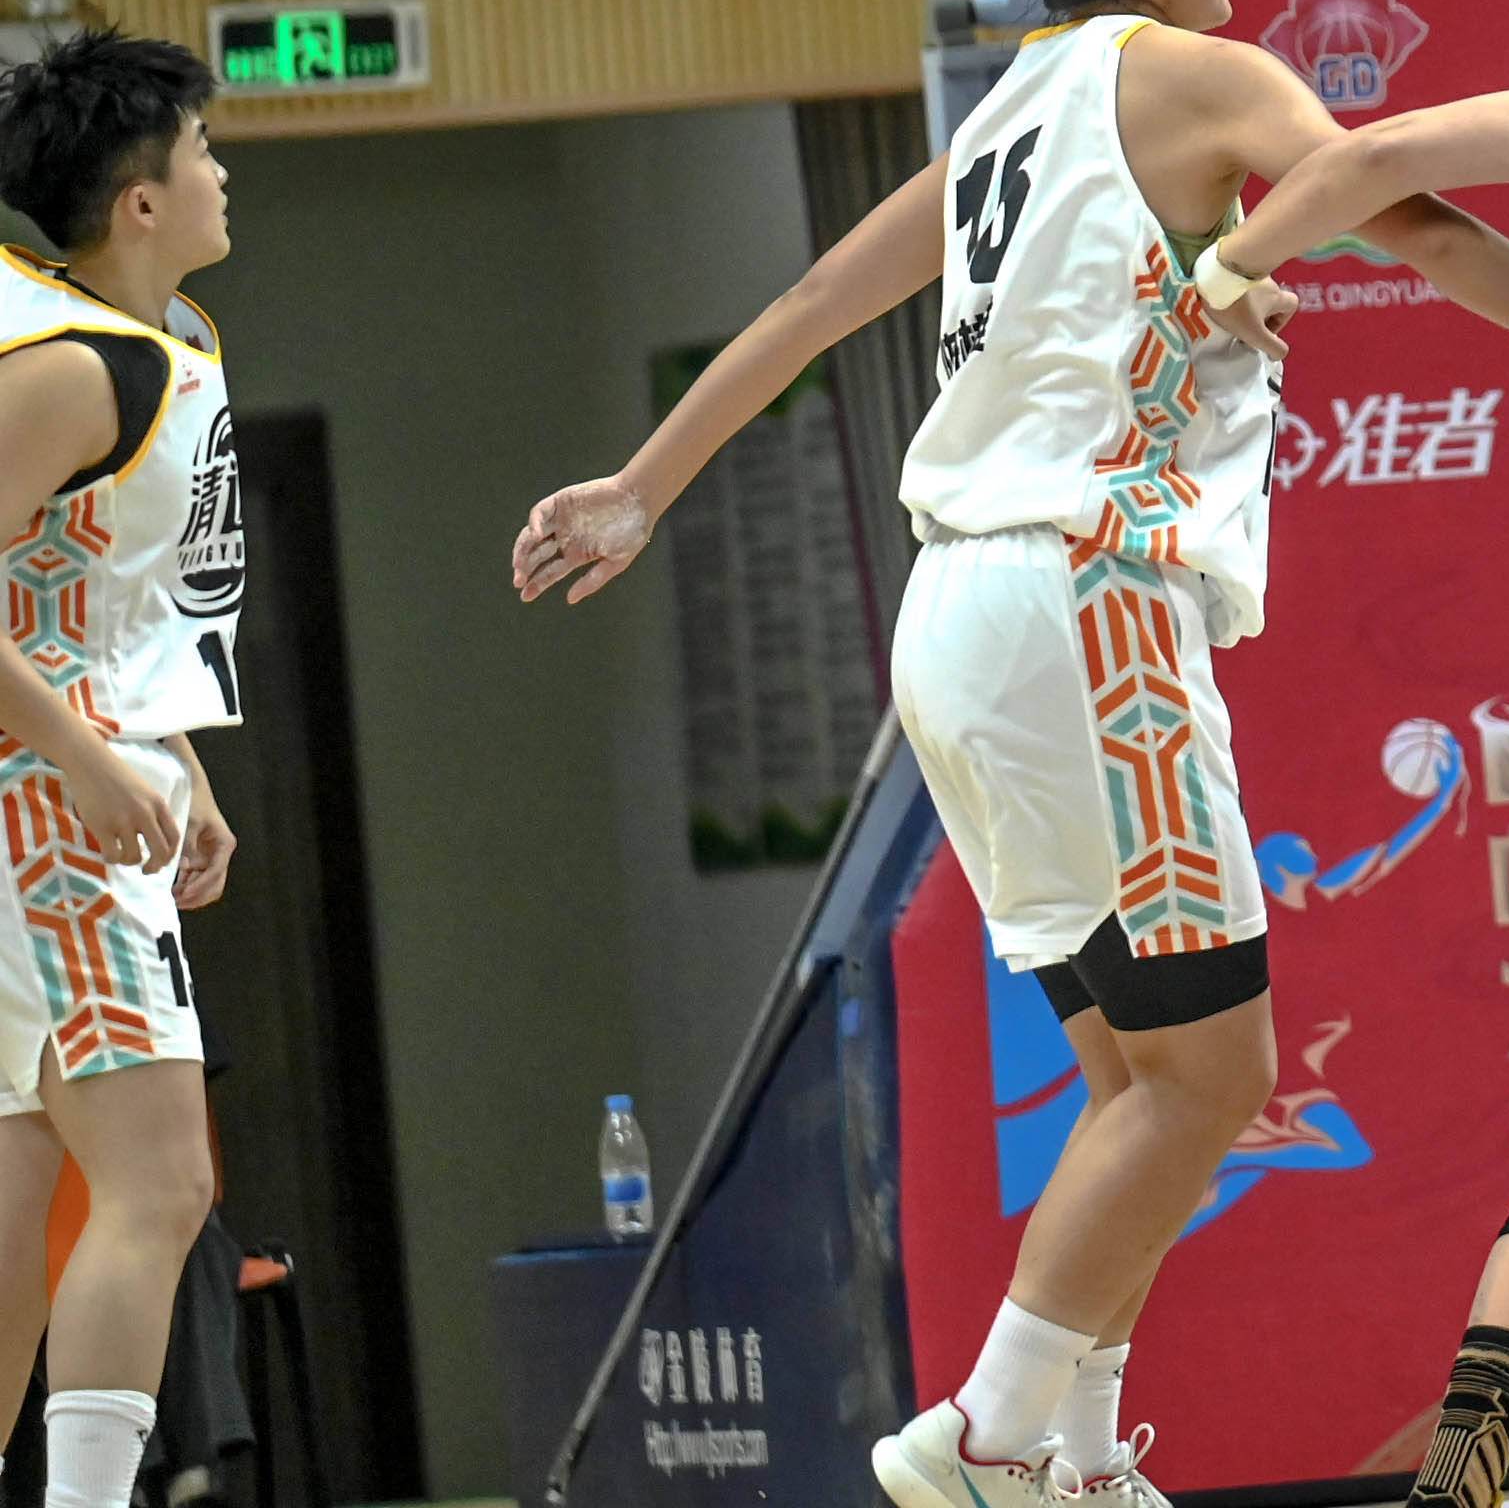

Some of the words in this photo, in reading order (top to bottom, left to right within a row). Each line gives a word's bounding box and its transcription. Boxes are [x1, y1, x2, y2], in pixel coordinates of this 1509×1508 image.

[1318, 57, 1379, 102] GD
[1327, 277, 1449, 311] QINGYUA
[1316, 388, 1504, 487] 准者
